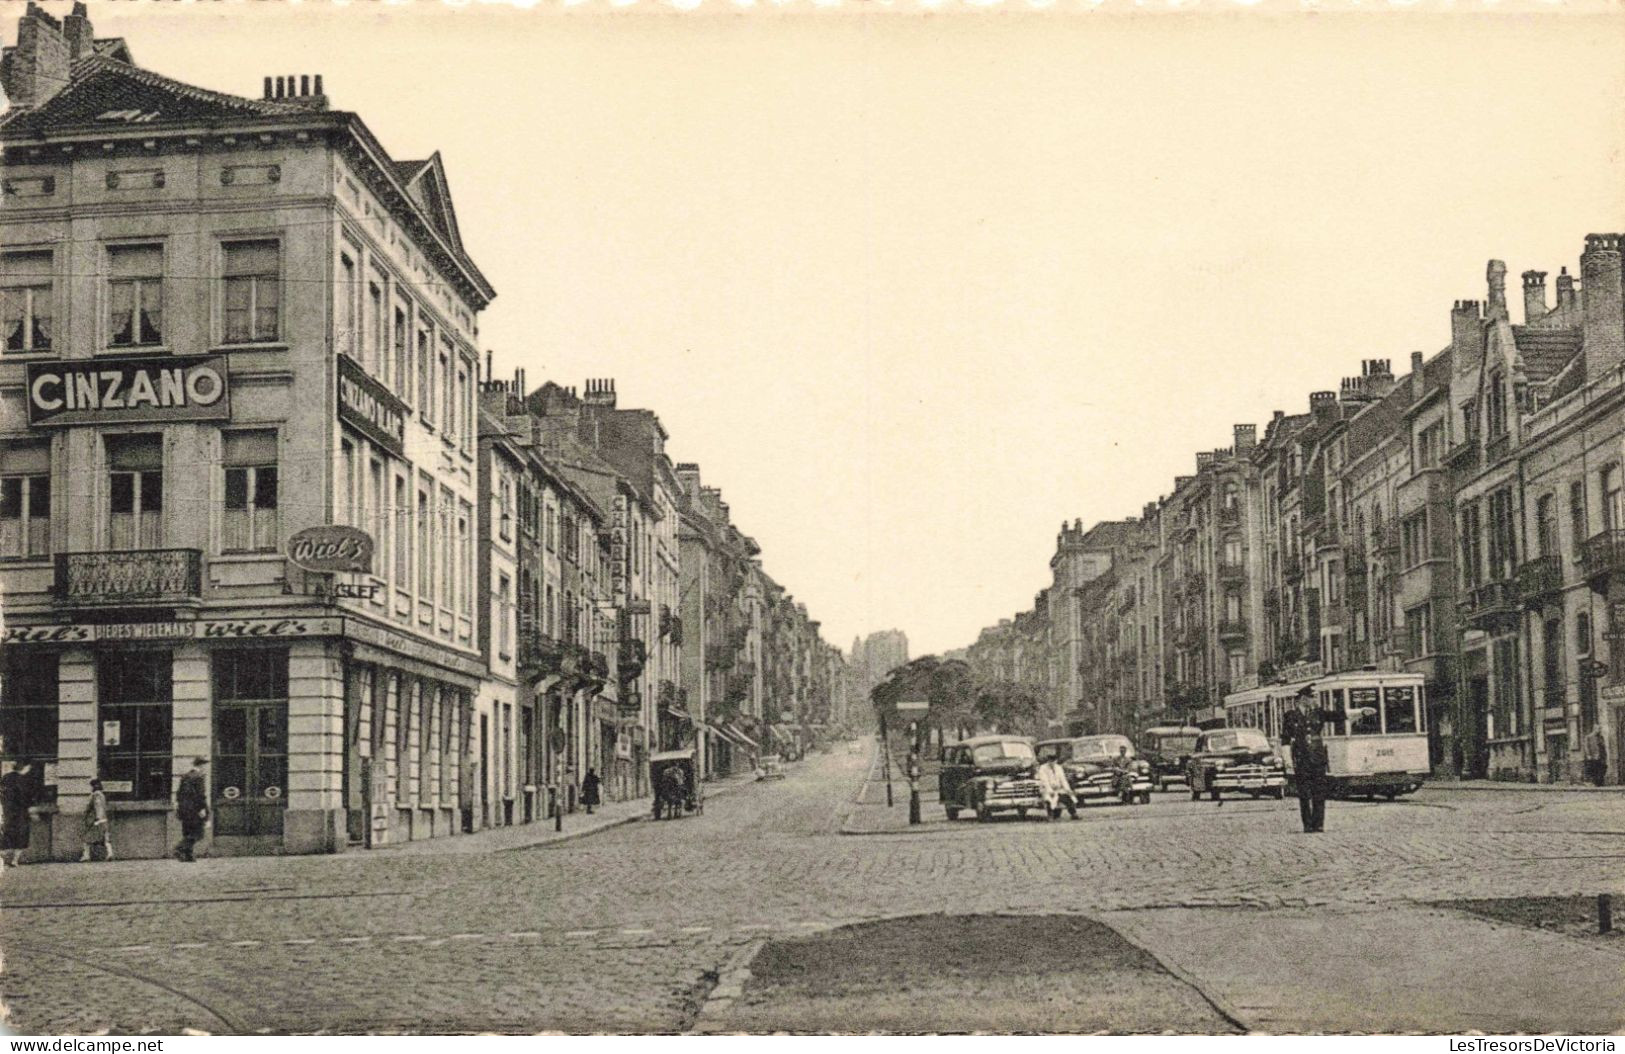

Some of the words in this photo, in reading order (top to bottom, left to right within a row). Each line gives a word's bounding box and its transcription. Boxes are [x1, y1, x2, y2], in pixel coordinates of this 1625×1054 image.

[31, 366, 223, 411] CINZANO
[341, 375, 376, 423] CINZANO
[295, 538, 365, 561] Wiel's
[335, 583, 381, 600] CLEF
[133, 621, 194, 637] WIELEMANS
[204, 620, 307, 637] Wiel's
